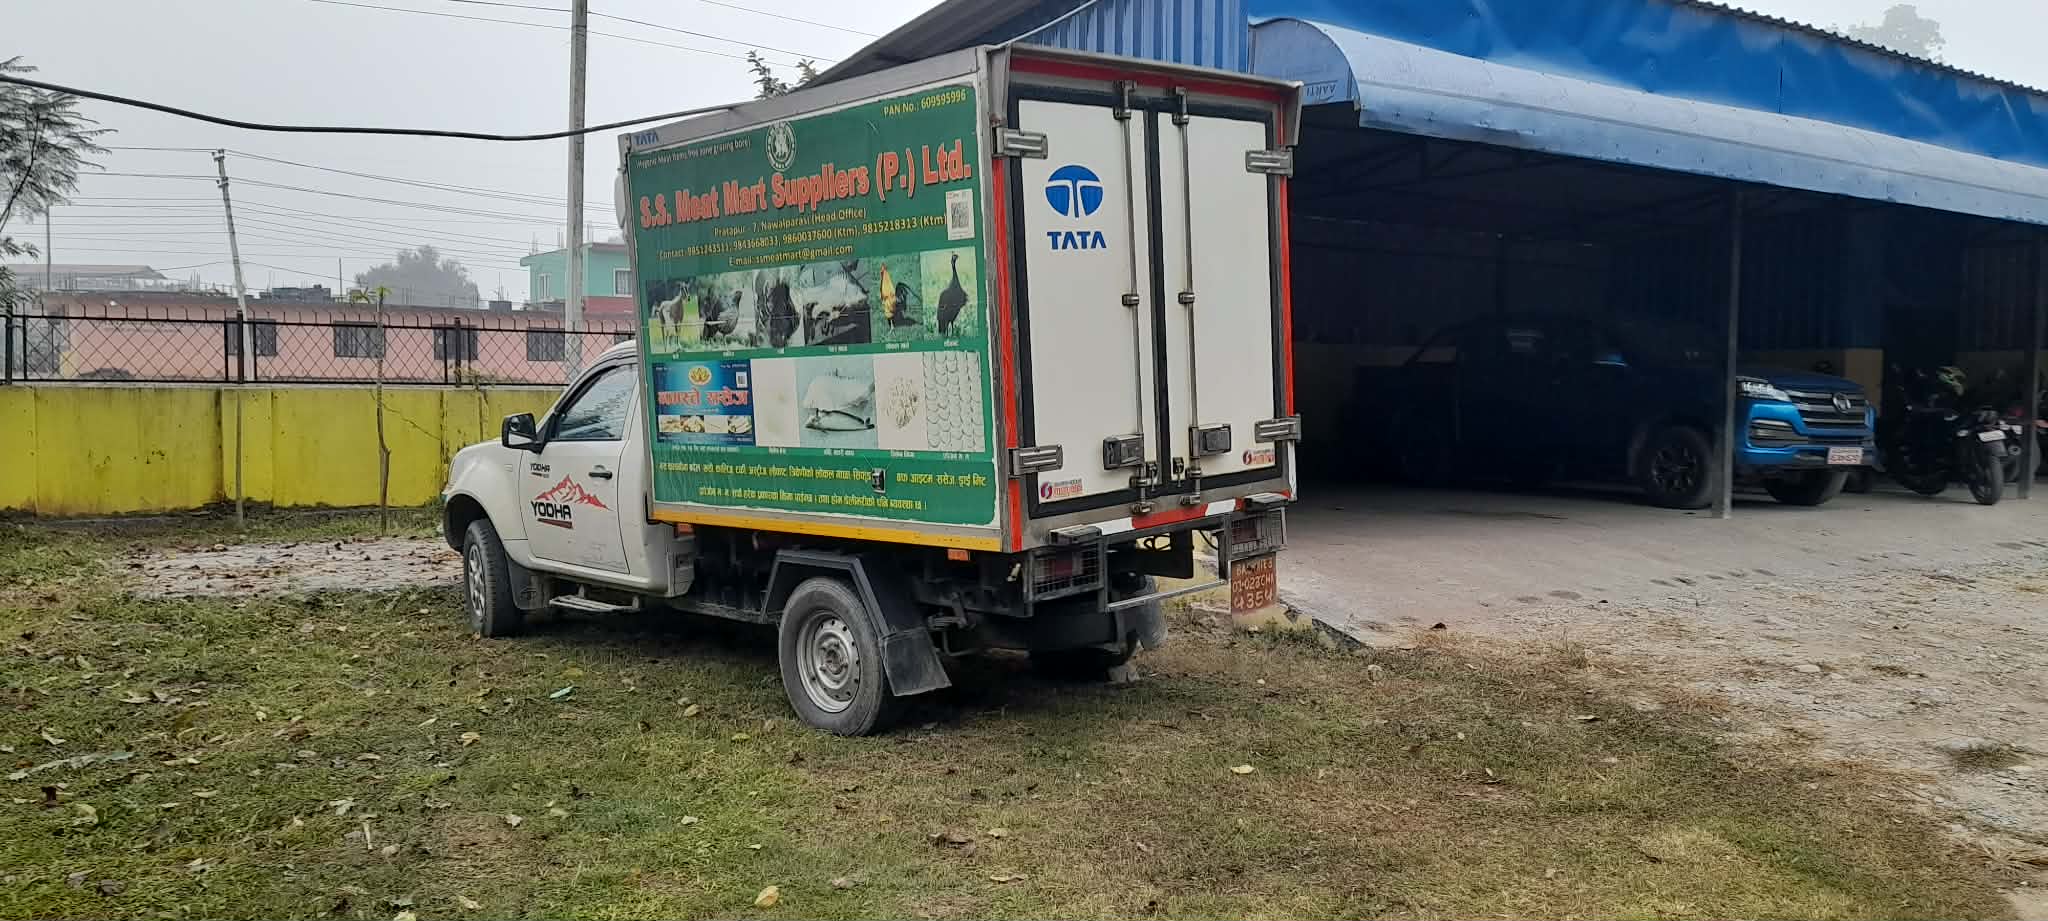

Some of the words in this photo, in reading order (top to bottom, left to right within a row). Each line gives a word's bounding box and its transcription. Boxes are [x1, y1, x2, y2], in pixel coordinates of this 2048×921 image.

[884, 104, 900, 117] PAN
[634, 132, 659, 146] TATA
[640, 193, 672, 229] S.S.
[675, 186, 720, 223] Meat
[723, 177, 768, 216] Mart
[772, 164, 870, 212] Suppliers
[876, 148, 915, 201] (P.)
[921, 139, 972, 186] Ltd.
[714, 225, 745, 237] Pratapur
[811, 211, 837, 225] (Head
[838, 207, 867, 220] Office)
[1047, 231, 1107, 250] TATA
[530, 500, 572, 520] YODHA
